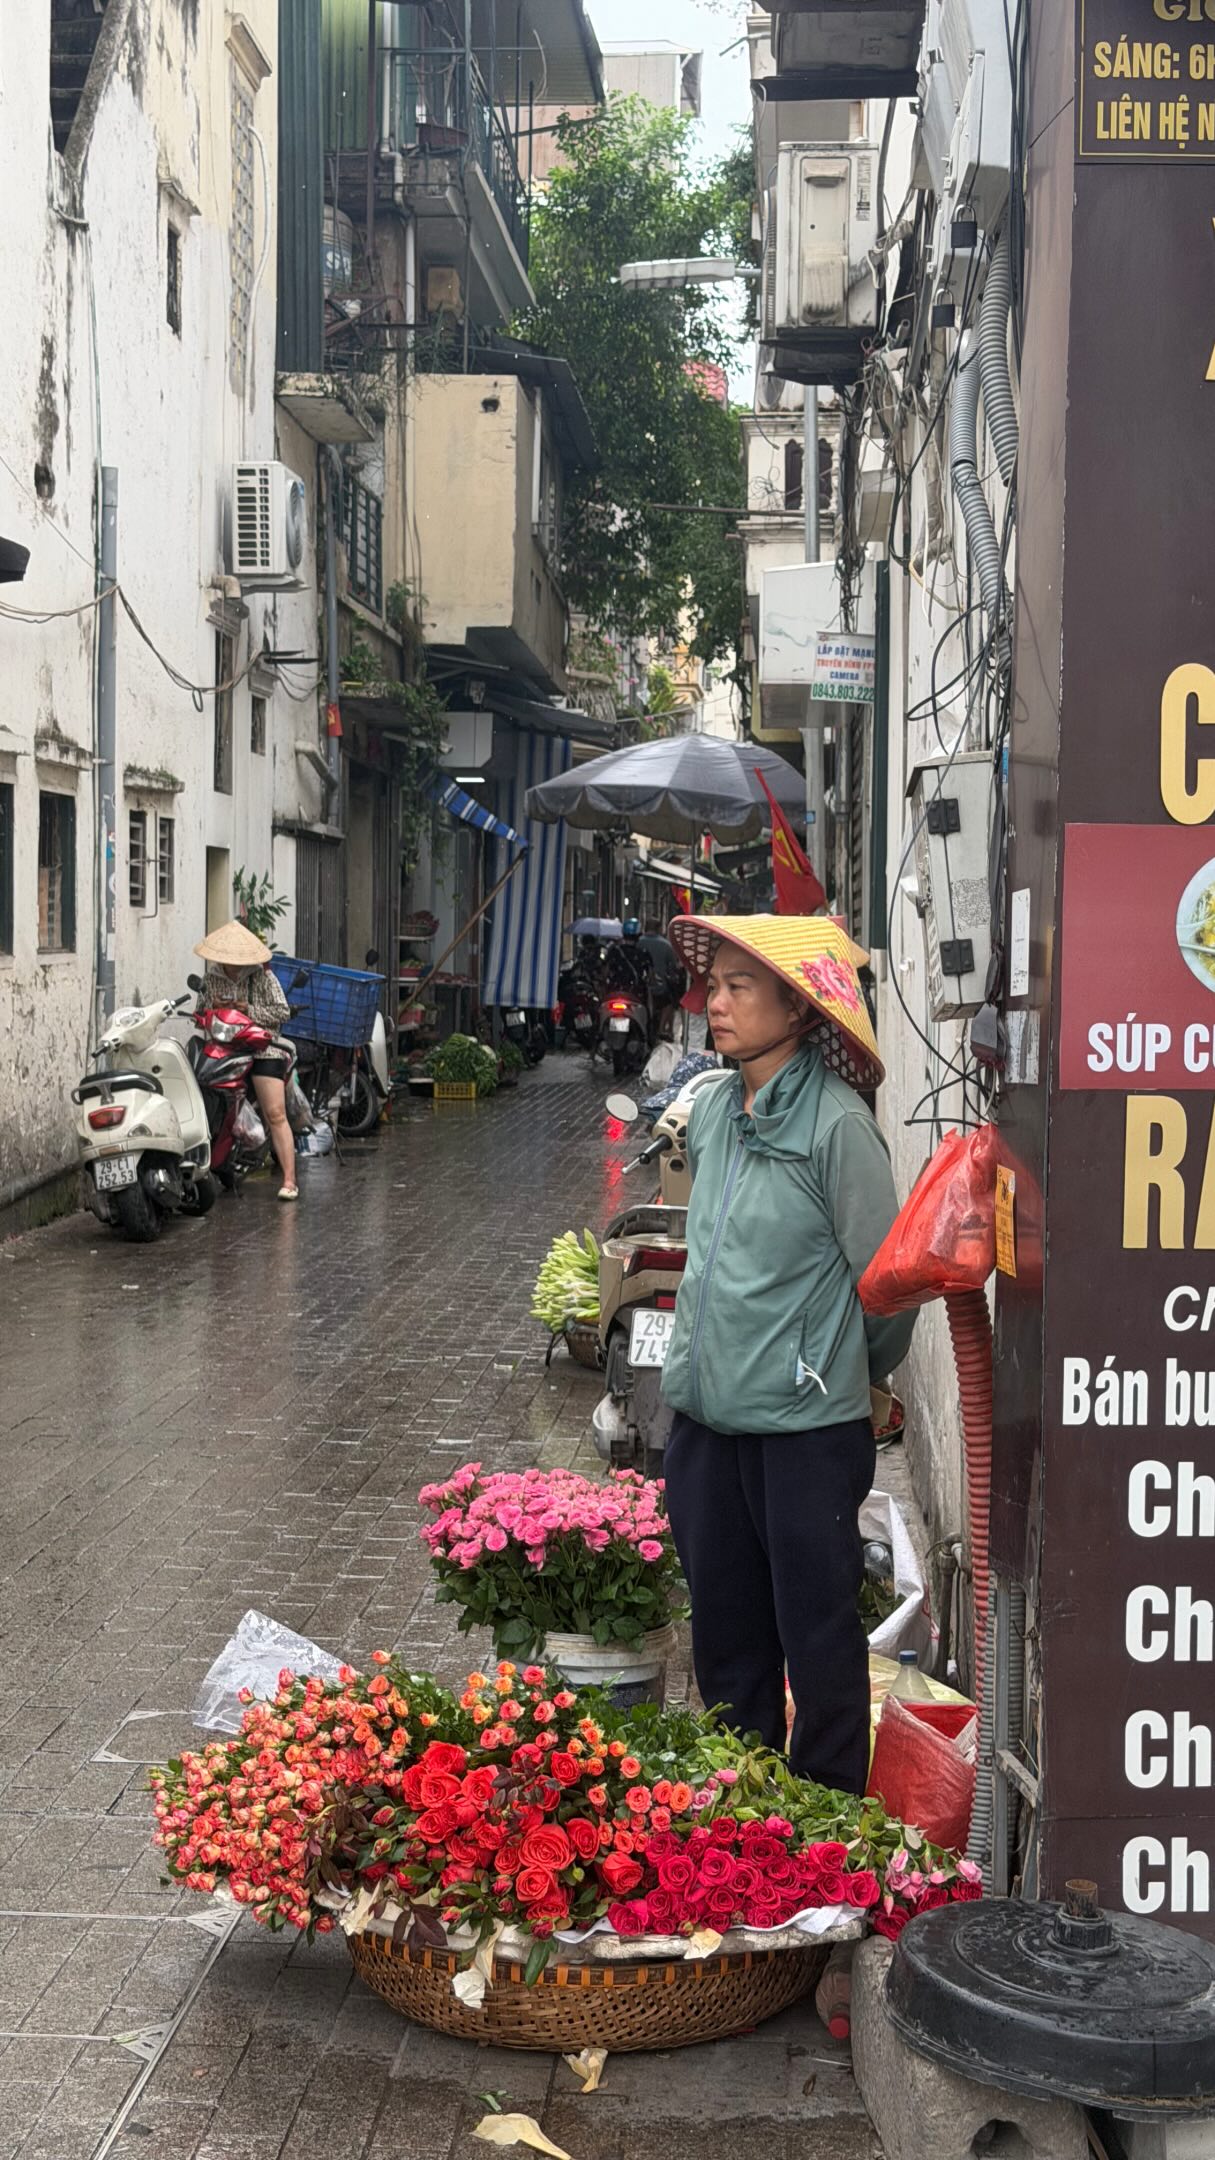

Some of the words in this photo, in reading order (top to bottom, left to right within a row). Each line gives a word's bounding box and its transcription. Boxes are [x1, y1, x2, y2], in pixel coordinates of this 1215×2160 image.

[1093, 34, 1180, 79] SÁNG:
[1097, 93, 1151, 140] LIÊN
[1159, 94, 1190, 149] HỆ
[830, 671, 859, 680] CAMERA
[1087, 1012, 1172, 1073] SÚP
[1184, 1023, 1215, 1073] C
[1062, 1355, 1149, 1426] Bán
[1128, 1459, 1215, 1537] Ch
[1126, 1584, 1213, 1662] Ch
[1124, 1709, 1212, 1788] Ch
[1122, 1836, 1210, 1914] Ch
